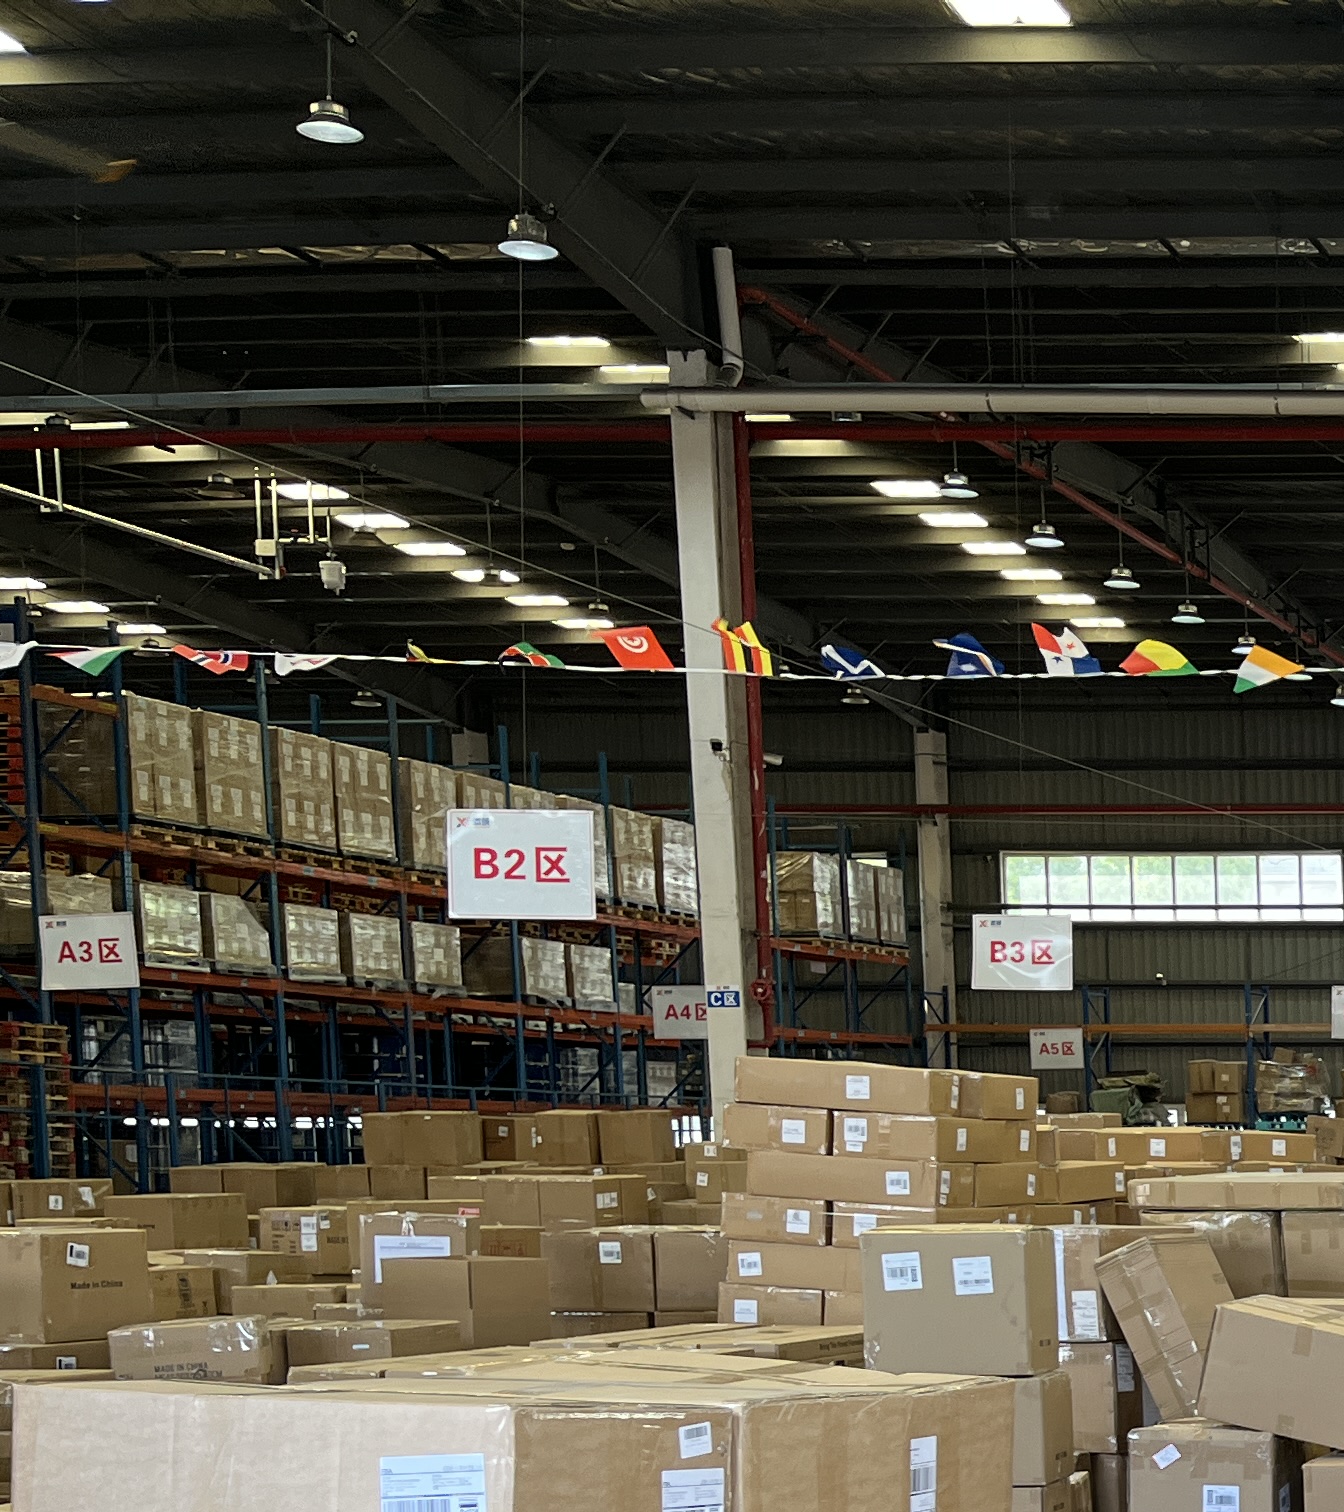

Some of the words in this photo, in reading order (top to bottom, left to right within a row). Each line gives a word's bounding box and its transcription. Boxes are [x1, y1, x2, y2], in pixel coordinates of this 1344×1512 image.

[474, 847, 569, 882] B2区
[60, 938, 121, 963] A3区
[991, 941, 1052, 965] B3区
[710, 994, 737, 1006] C区
[666, 1003, 707, 1020] A4区
[1040, 1041, 1074, 1056] A5区
[71, 1282, 91, 1290] Made
[101, 1280, 123, 1289] China
